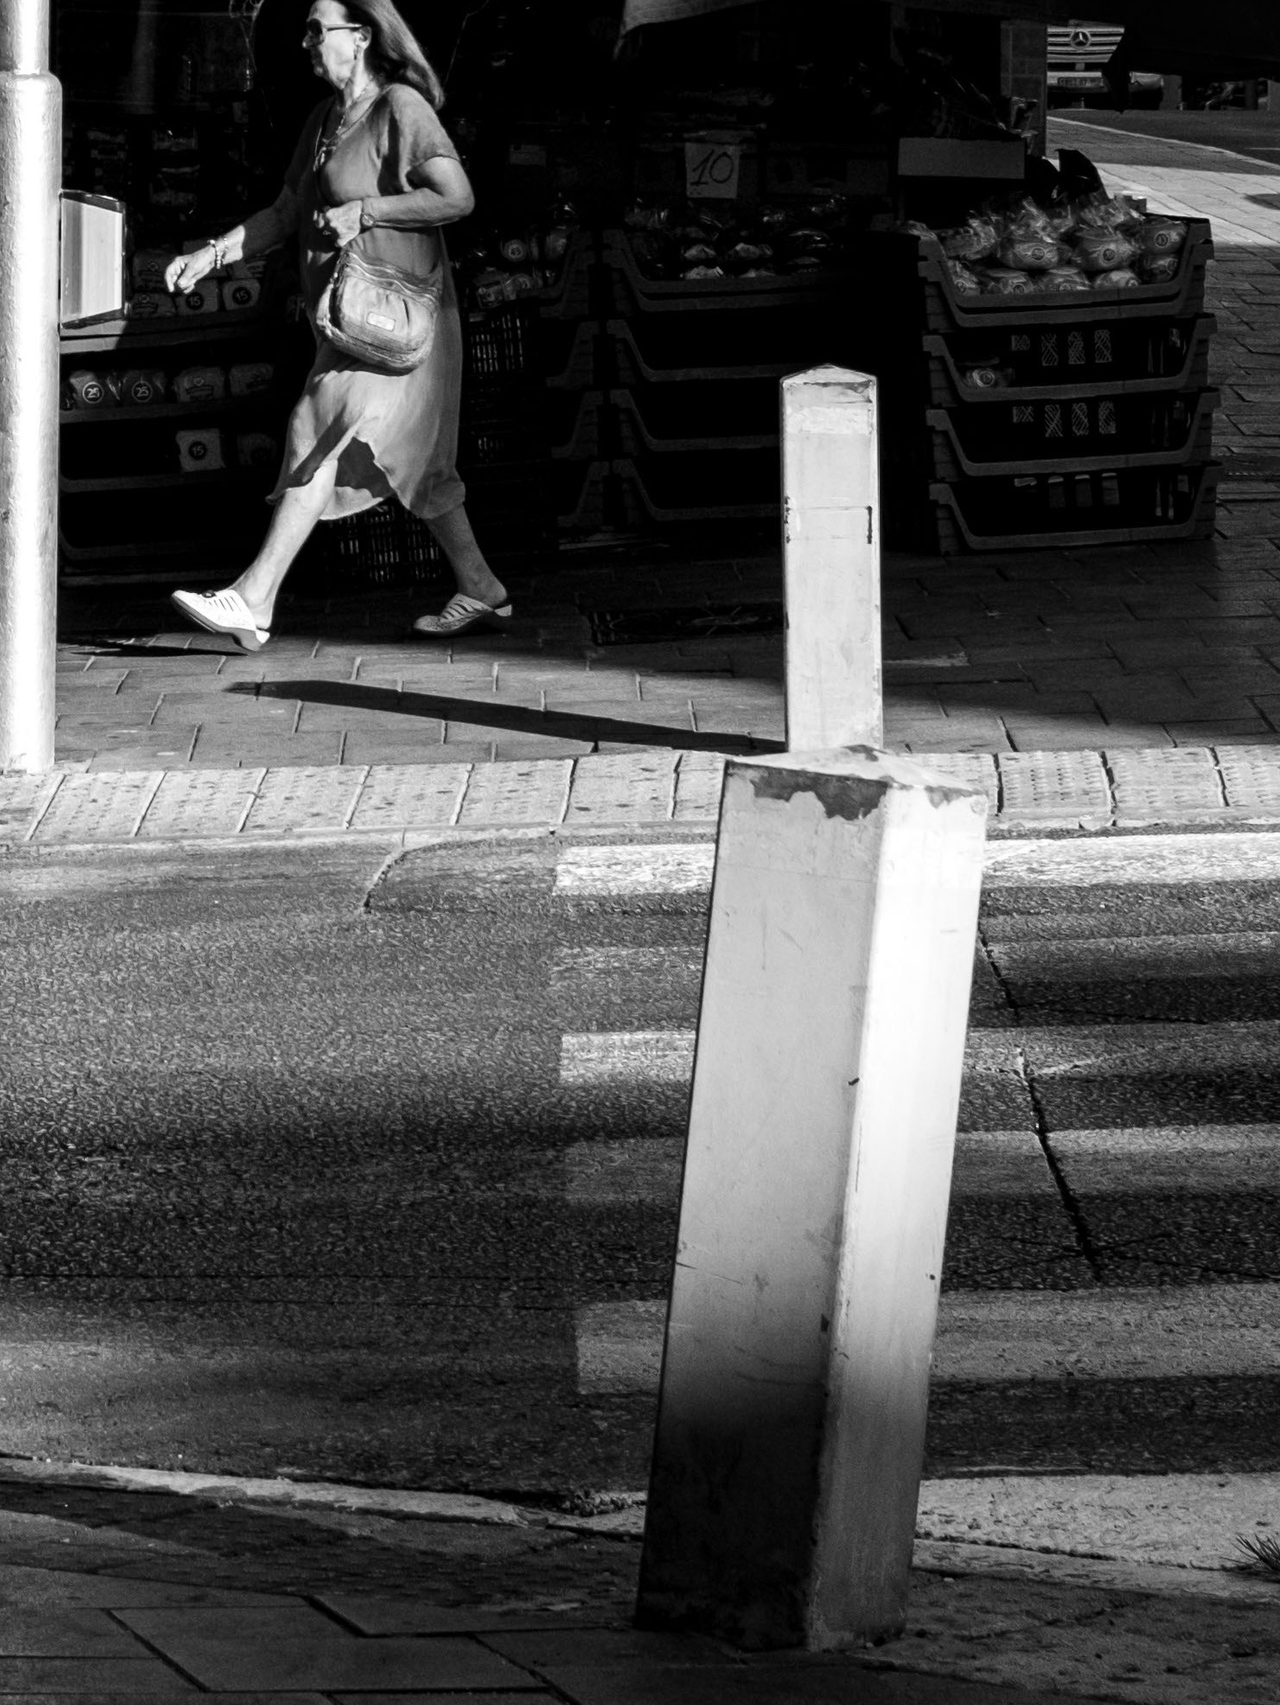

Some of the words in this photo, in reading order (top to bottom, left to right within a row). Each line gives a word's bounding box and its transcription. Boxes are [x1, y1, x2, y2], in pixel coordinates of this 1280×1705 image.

[690, 149, 734, 187] 10
[234, 291, 248, 301] 15
[188, 297, 201, 307] 15
[86, 387, 100, 399] 25
[135, 386, 149, 397] 25
[191, 445, 205, 456] 15
